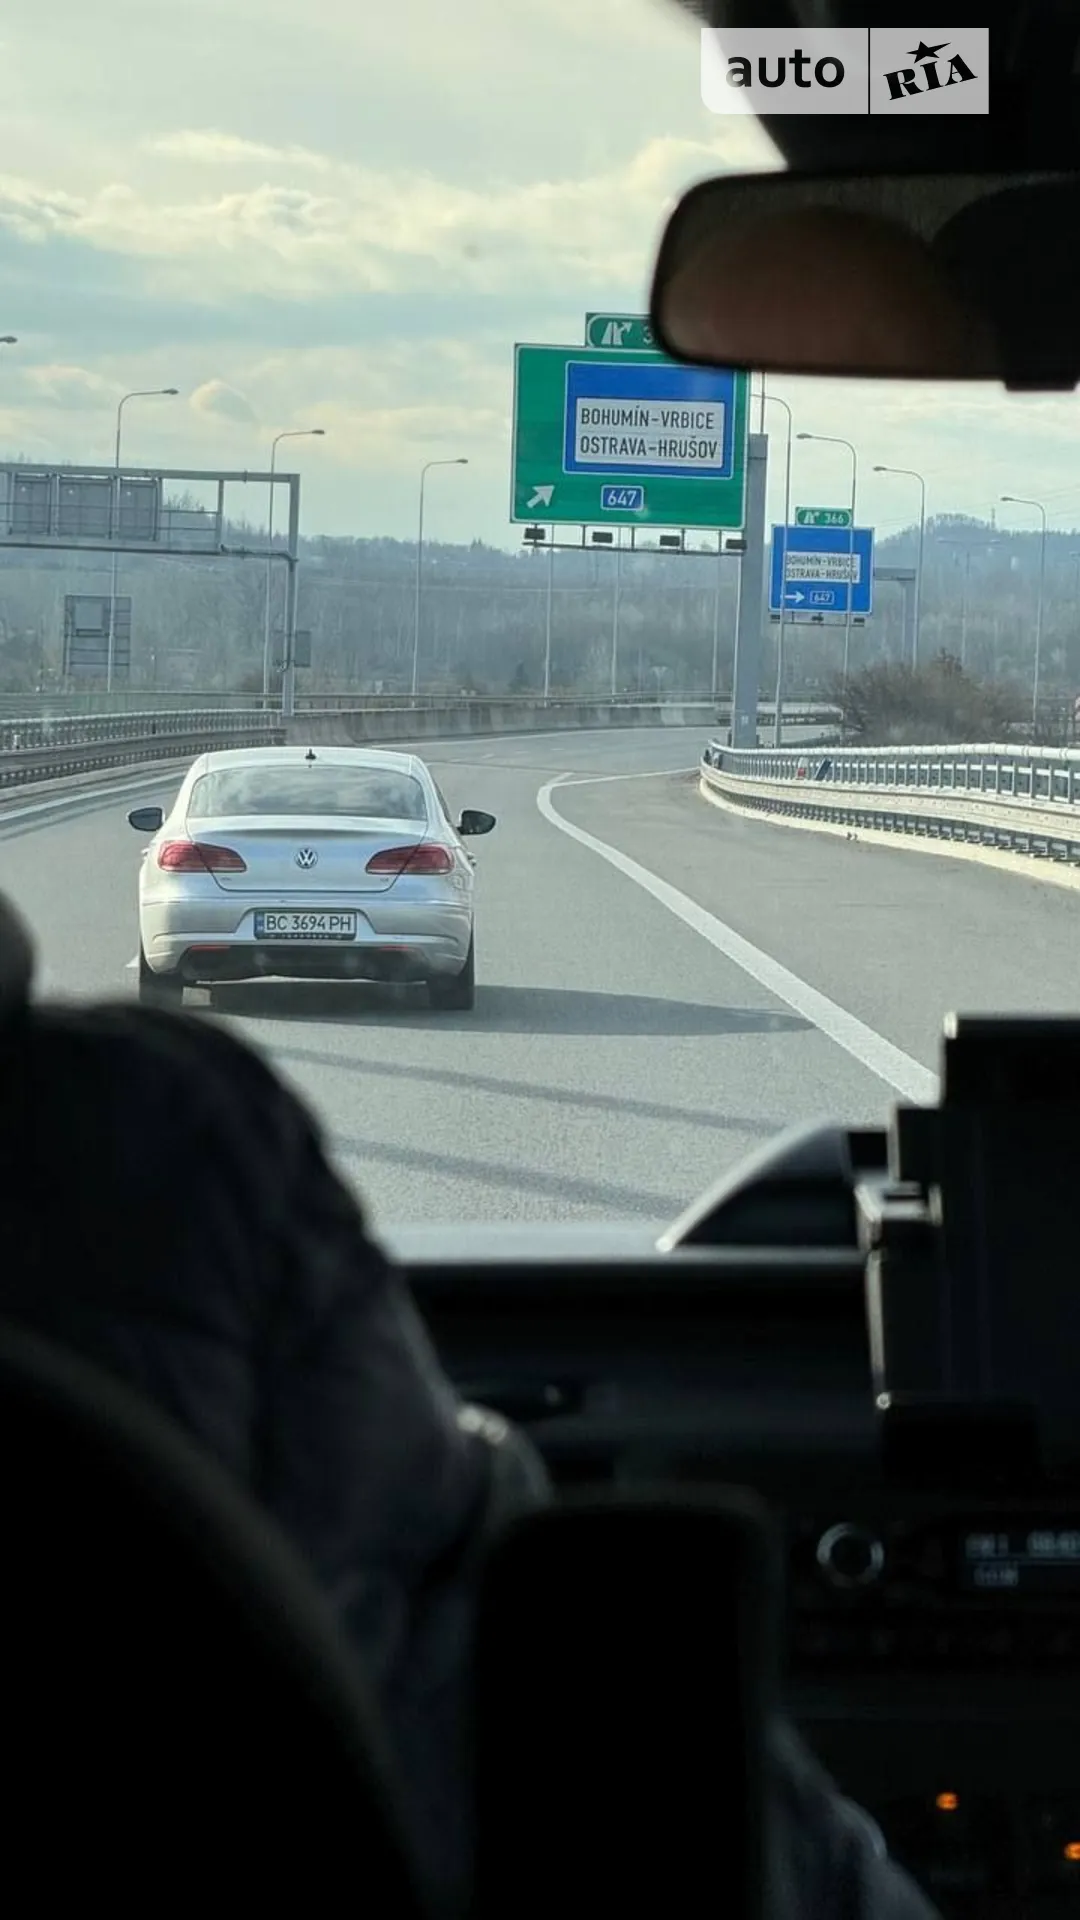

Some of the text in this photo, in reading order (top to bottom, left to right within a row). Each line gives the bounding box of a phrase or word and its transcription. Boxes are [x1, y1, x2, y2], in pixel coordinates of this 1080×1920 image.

[580, 405, 715, 430] BOHUMÍN-VRBICE
[580, 435, 718, 460] OSTRAVA-HRUŠOV
[606, 489, 638, 506] 647
[266, 915, 352, 932] BC 3694 PH
